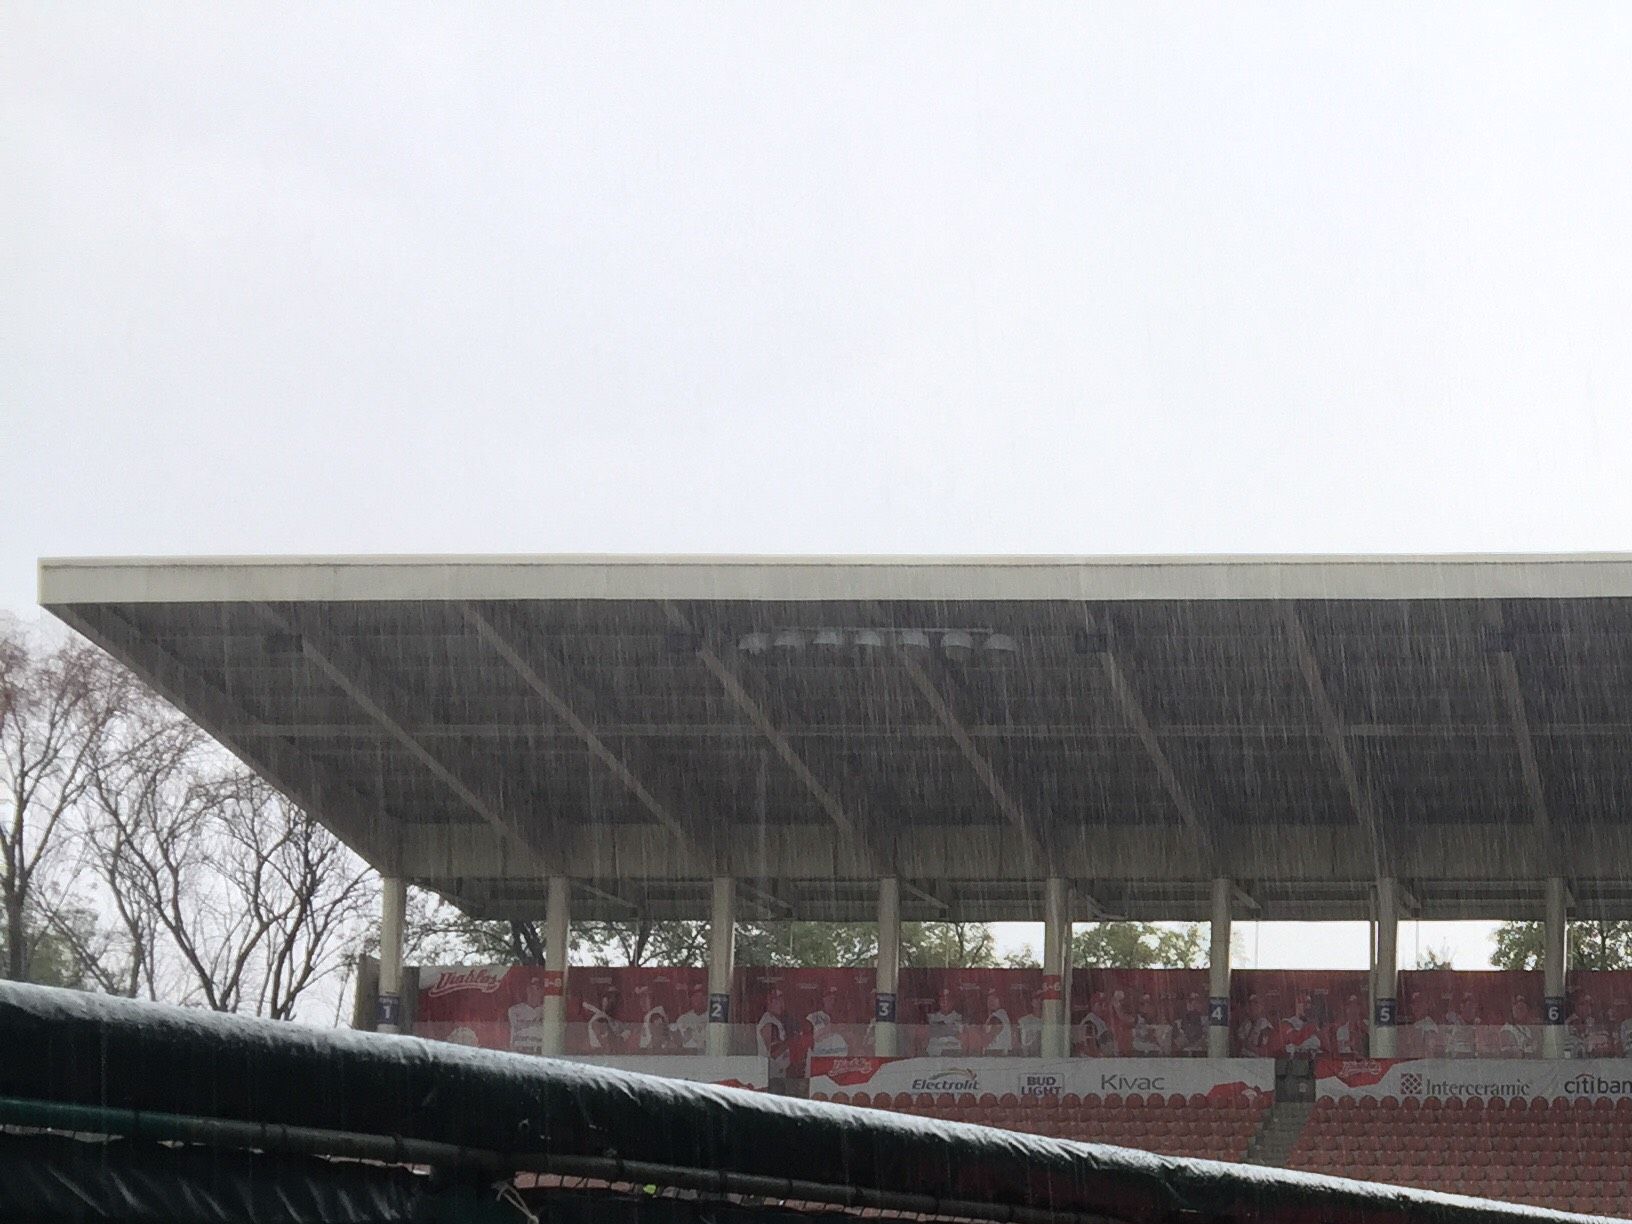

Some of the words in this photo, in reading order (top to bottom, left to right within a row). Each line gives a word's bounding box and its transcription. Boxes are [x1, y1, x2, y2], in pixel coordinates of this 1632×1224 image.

[430, 969, 501, 995] Diablos
[711, 1004, 722, 1017] 2
[879, 1003, 889, 1017] 3
[1212, 1006, 1223, 1020] 4
[1380, 1007, 1391, 1021] 5
[1548, 1006, 1559, 1020] 6
[912, 1078, 981, 1091] Electrolit
[1026, 1076, 1056, 1087] BUD
[1426, 1078, 1530, 1096] Interceramic
[1021, 1086, 1063, 1097] LIGHT
